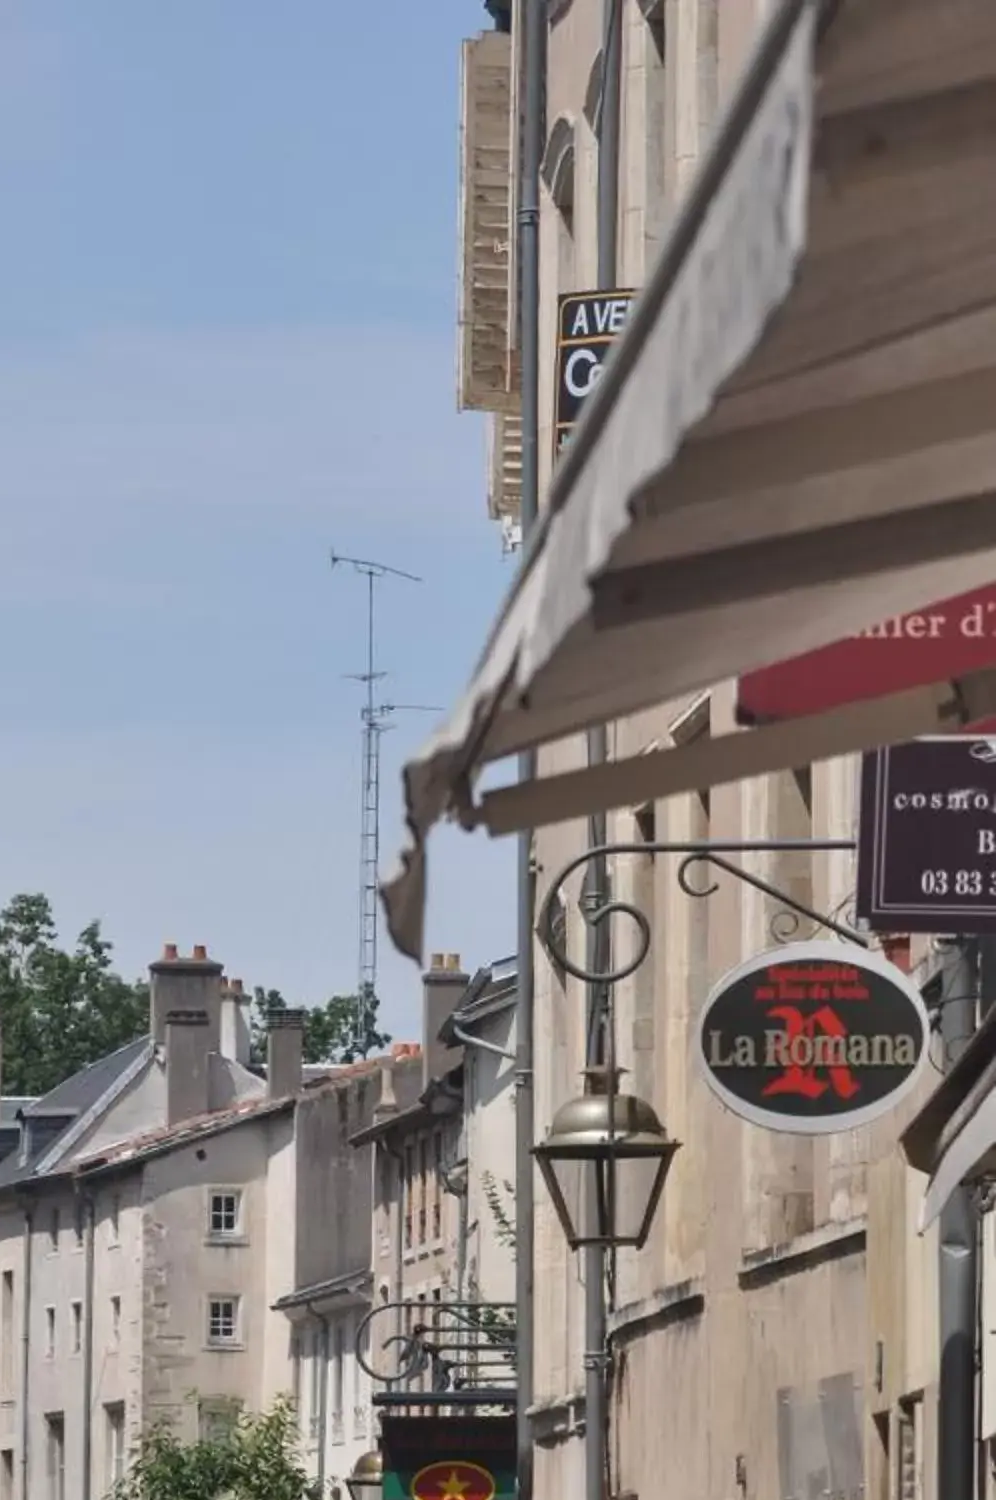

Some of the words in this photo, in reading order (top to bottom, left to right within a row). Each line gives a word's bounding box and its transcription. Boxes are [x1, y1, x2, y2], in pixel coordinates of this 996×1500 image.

[571, 303, 589, 335] A
[593, 301, 633, 333] VE
[894, 790, 996, 813] cosmo
[921, 869, 949, 896] 03
[954, 869, 982, 896] 83
[709, 1029, 757, 1066] La
[764, 1029, 916, 1067] Romana
